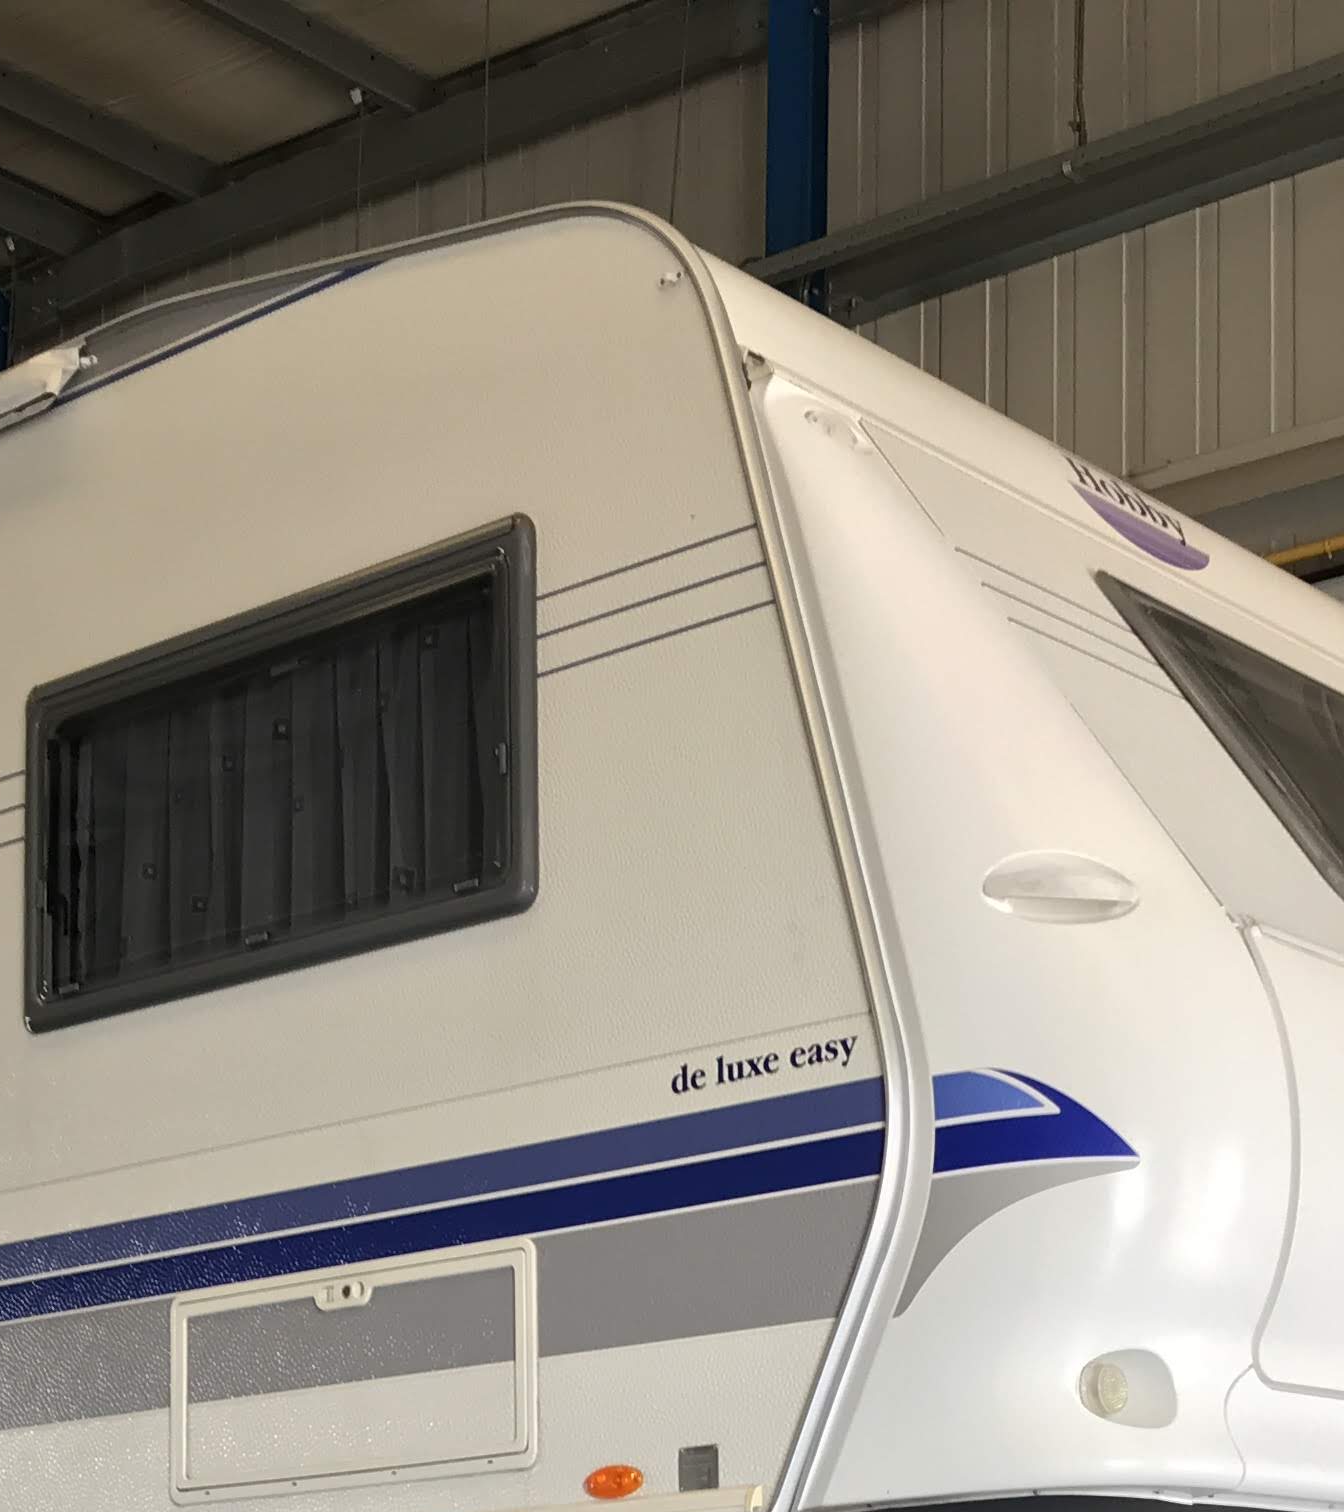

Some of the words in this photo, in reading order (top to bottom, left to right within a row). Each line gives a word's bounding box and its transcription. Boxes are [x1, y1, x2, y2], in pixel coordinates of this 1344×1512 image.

[1065, 456, 1186, 547] Hobby
[671, 1063, 706, 1095] de
[715, 1052, 780, 1085] luxe
[789, 1035, 858, 1067] easy
